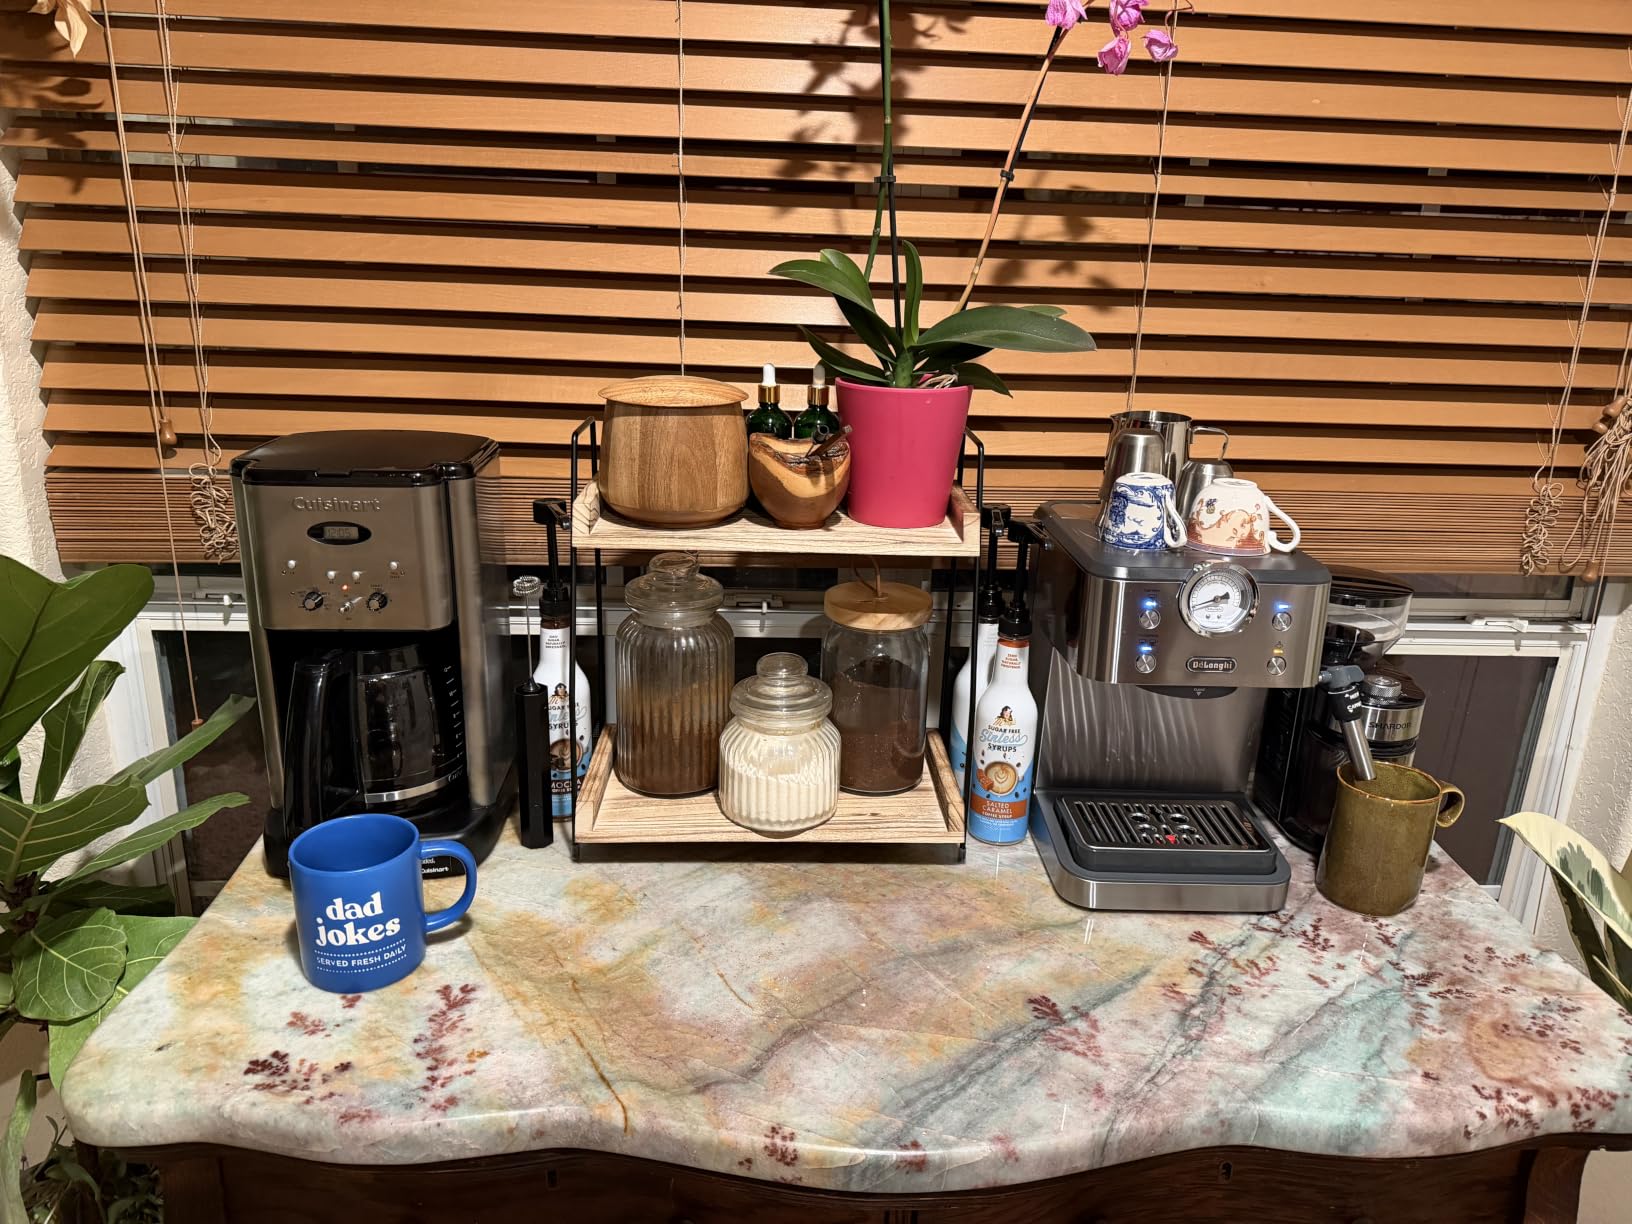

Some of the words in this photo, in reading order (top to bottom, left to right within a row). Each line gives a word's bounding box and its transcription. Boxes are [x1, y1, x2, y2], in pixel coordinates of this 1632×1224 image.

[291, 496, 381, 512] Cuisinart
[980, 728, 1029, 747] Sinless
[988, 743, 1017, 752] SYRUPS
[982, 804, 1013, 815] CARAMEL
[986, 800, 1010, 809] SALTED
[326, 891, 384, 920] dad
[316, 917, 401, 947] jokes
[316, 956, 349, 967] SERVED
[351, 955, 381, 967] FRESH
[383, 944, 407, 960] DAILY
